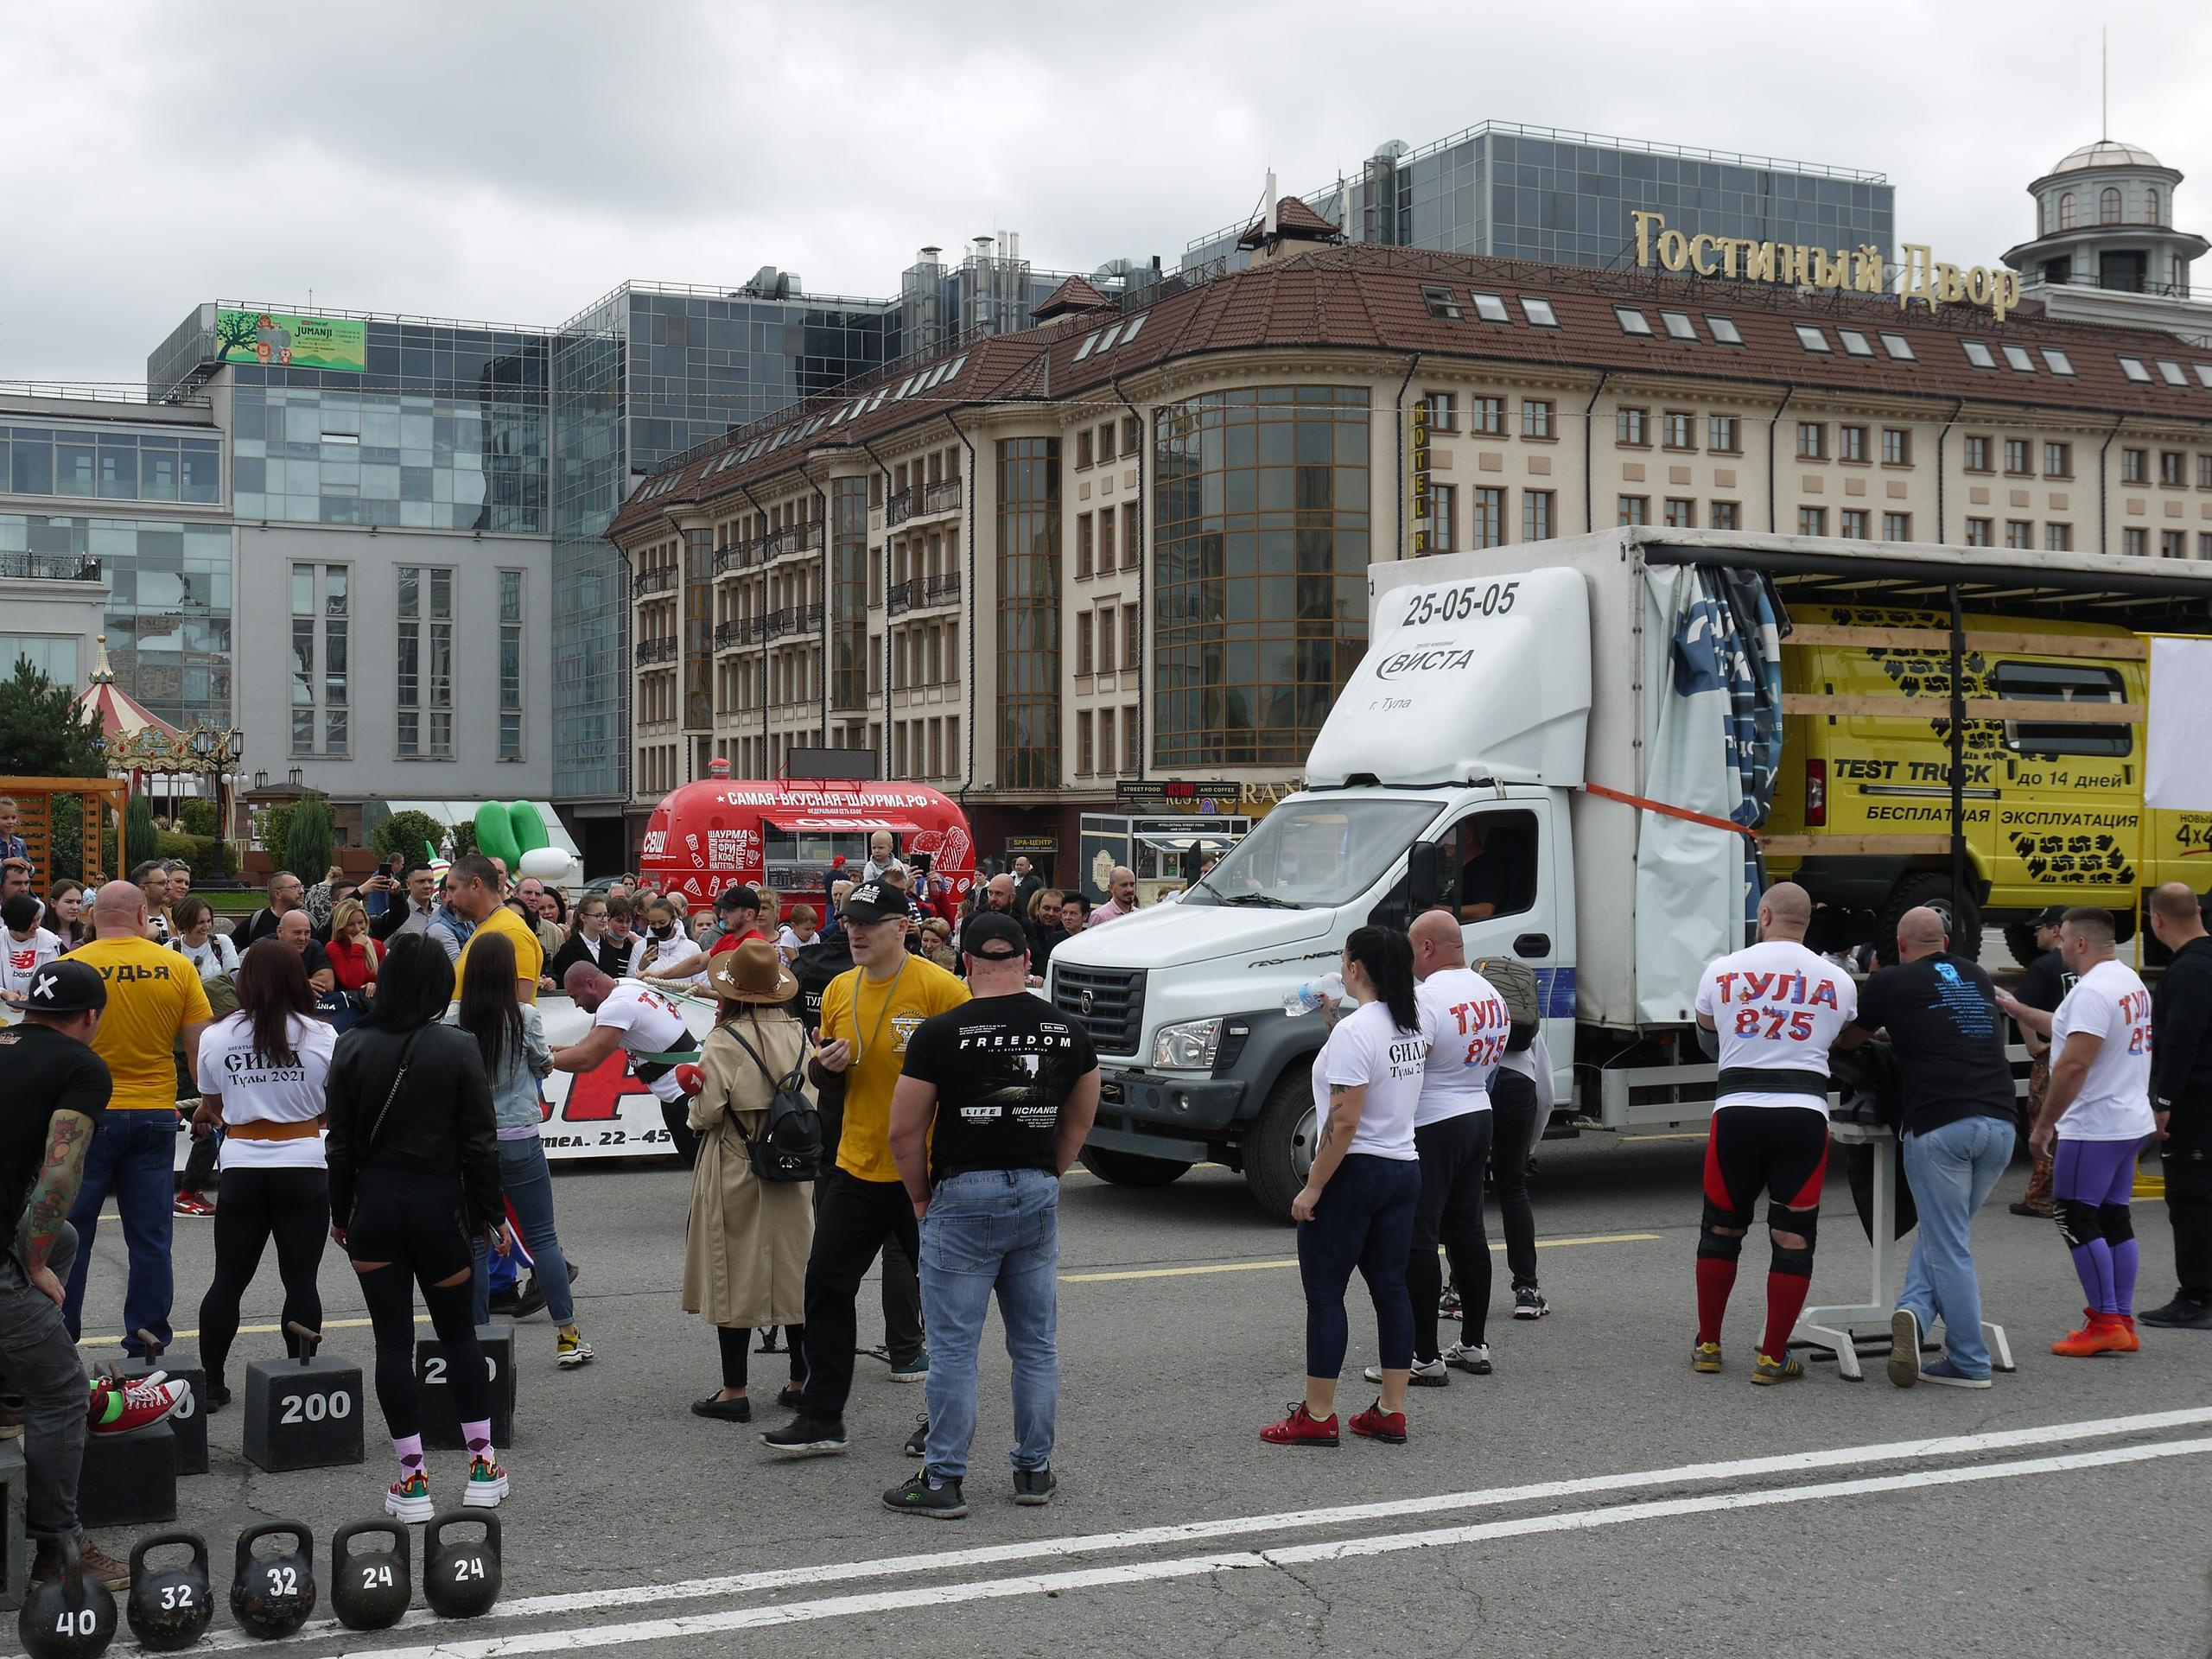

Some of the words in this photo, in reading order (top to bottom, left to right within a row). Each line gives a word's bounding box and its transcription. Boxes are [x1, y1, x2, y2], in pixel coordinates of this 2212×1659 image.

[1631, 210, 1883, 294] Гостиный
[1899, 244, 2020, 322] Двор
[295, 327, 332, 338] JUMANJI
[1415, 404, 1424, 516] HOTEL
[1402, 582, 1519, 626] 25-05-05
[1385, 650, 1474, 674] ВИСТА
[1382, 697, 1412, 711] Тула
[1834, 759, 1899, 779] TEST
[2018, 773, 2042, 786] до
[2050, 772, 2068, 785] 14
[2075, 774, 2122, 789] дней
[728, 791, 927, 808] САМАЯ-ВКУСНАЯ-ШАУРМА.РФ
[795, 818, 893, 827] СВШ
[2001, 810, 2139, 829] ЭКСПЛУАТАЦИЯ
[2180, 814, 2212, 823] НОВЫ
[644, 830, 666, 853] СВШ
[708, 830, 747, 839] ШАУРМА
[719, 843, 736, 854] ФРИ
[719, 852, 735, 861] КОФЕ
[1303, 950, 1344, 961] NEX
[99, 965, 169, 982] УДЬЯ
[1715, 969, 1839, 1011] ТУЛА
[2119, 989, 2152, 1026] ТУЛ
[1734, 1005, 1815, 1041] 875
[960, 1035, 1071, 1049] FREEDOM
[1463, 1034, 1507, 1068] 875
[228, 1074, 266, 1088] Тулы
[271, 1071, 305, 1082] 2021
[1389, 1065, 1414, 1080] Тулы
[280, 1390, 352, 1425] 200
[362, 1566, 393, 1589] 24
[454, 1557, 485, 1581] 24
[266, 1567, 298, 1597] 32
[161, 1584, 194, 1611] 32
[55, 1609, 97, 1637] 40
